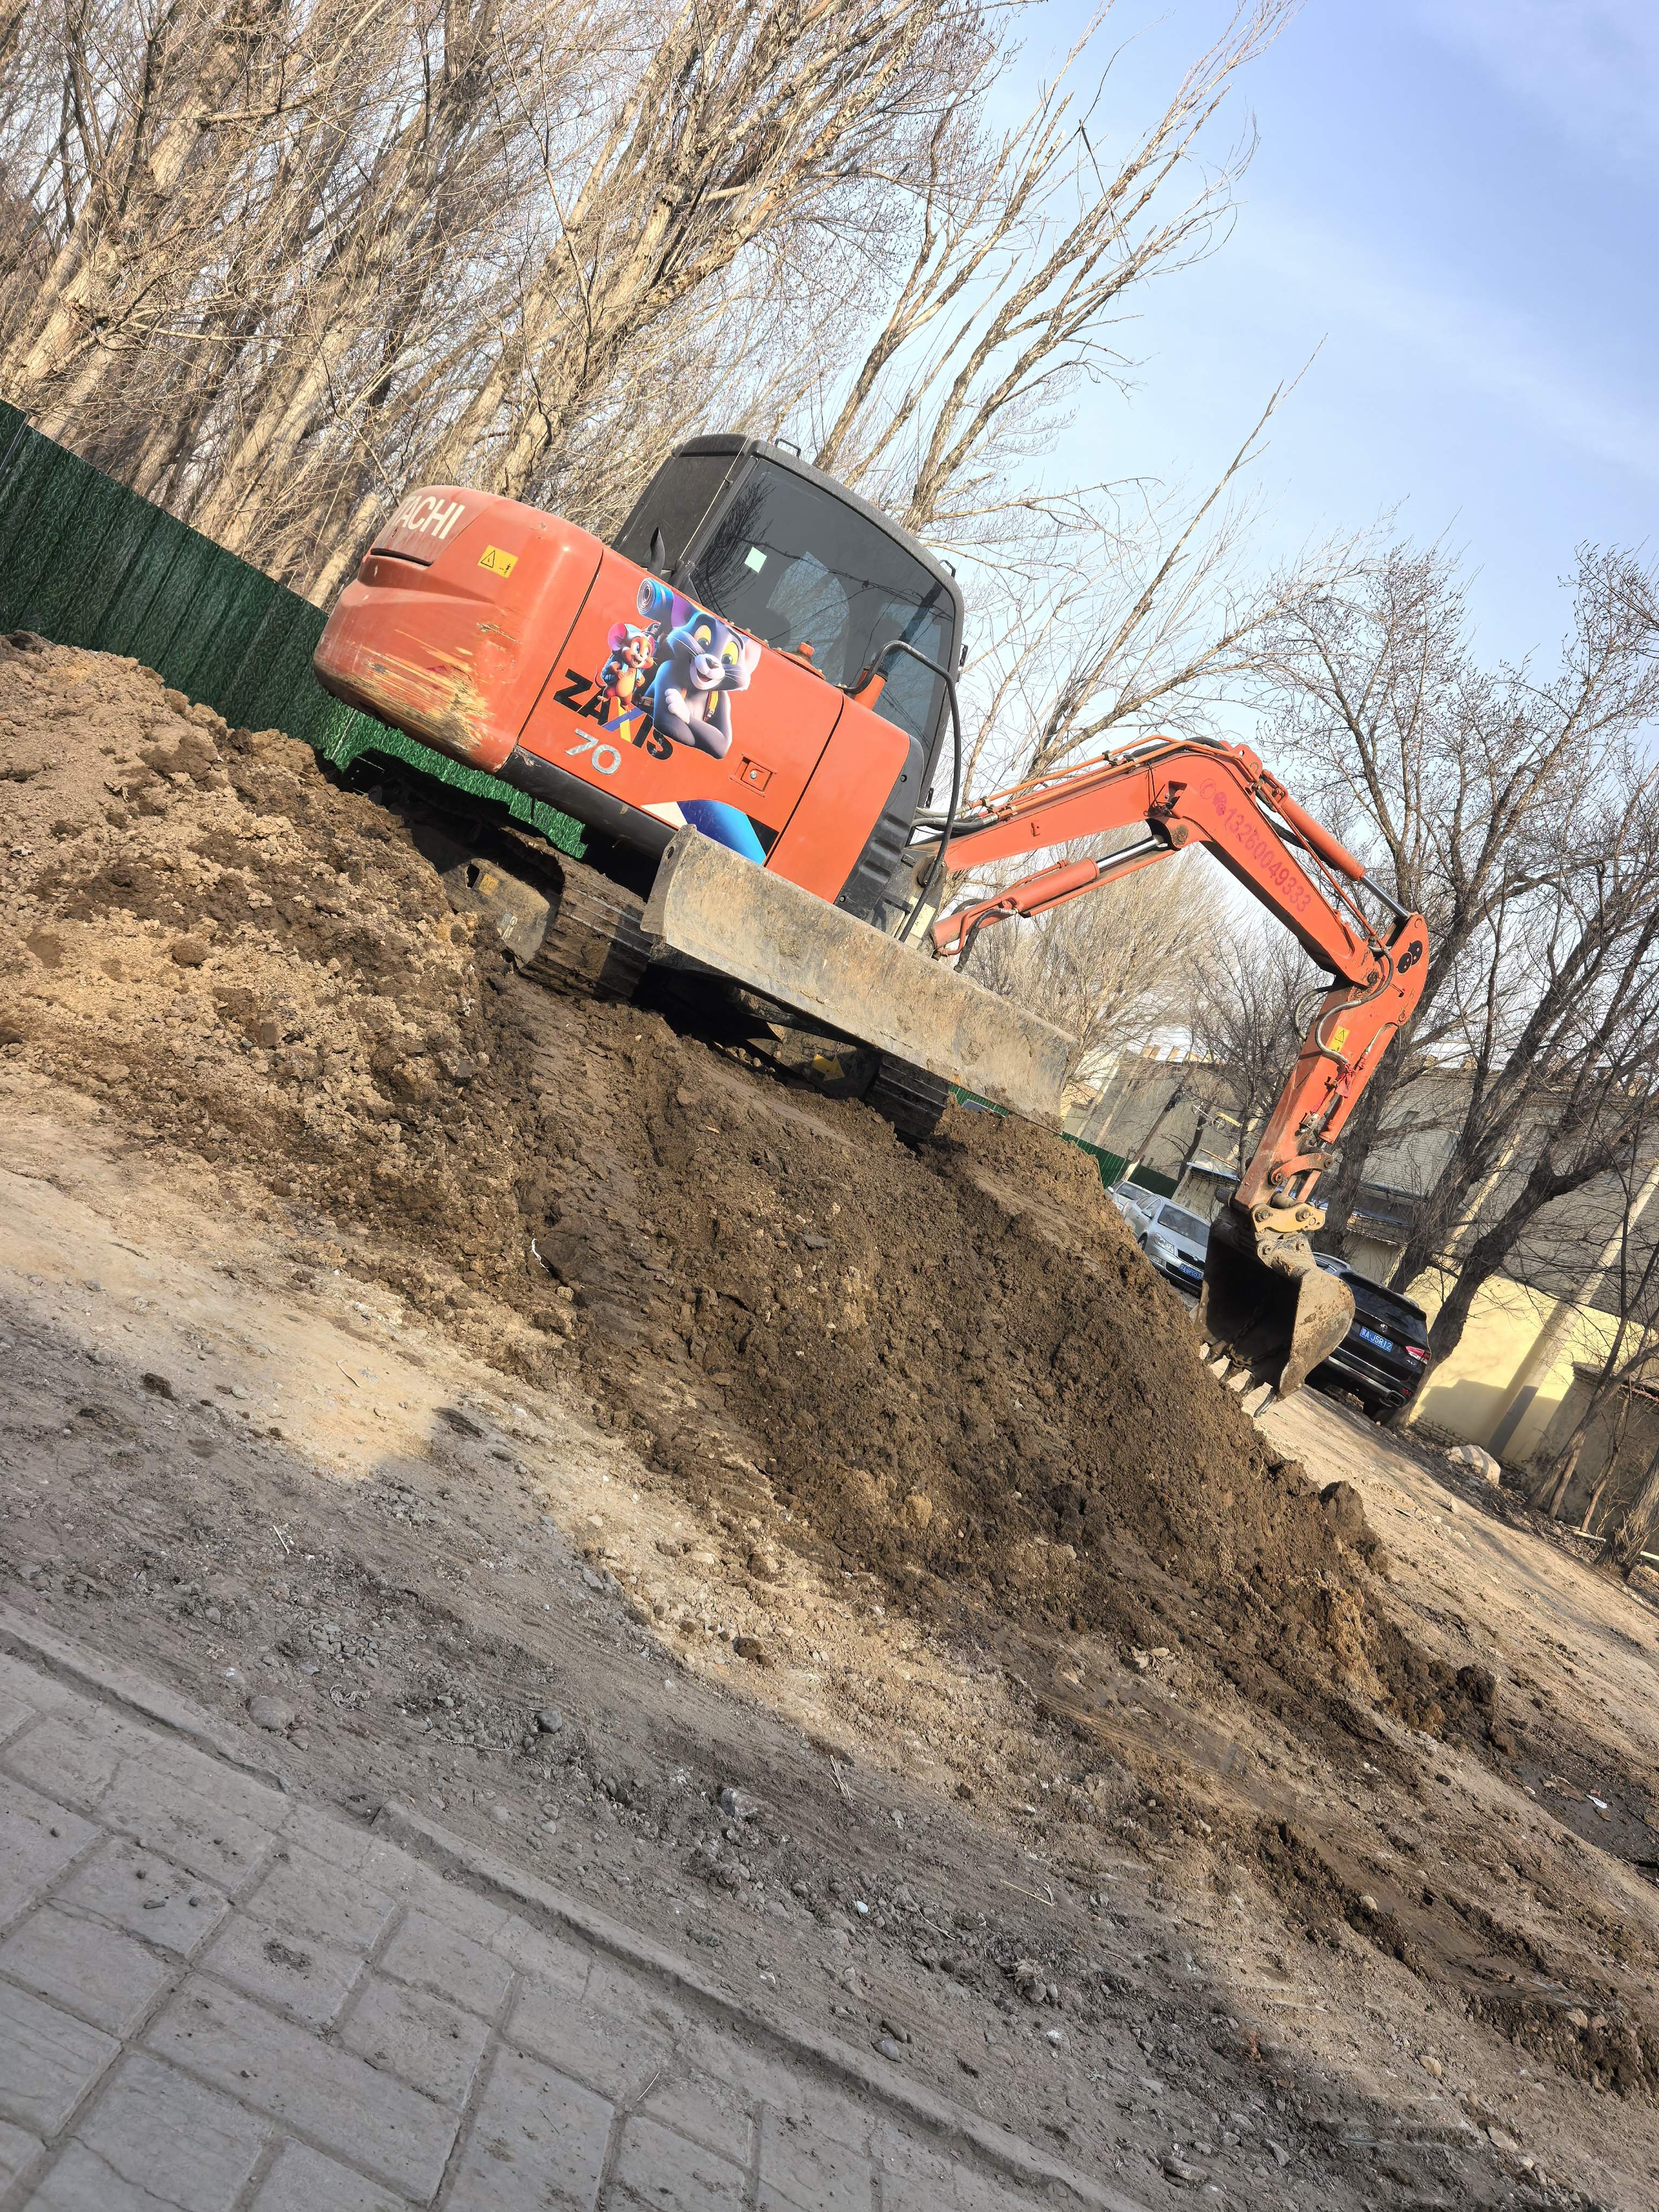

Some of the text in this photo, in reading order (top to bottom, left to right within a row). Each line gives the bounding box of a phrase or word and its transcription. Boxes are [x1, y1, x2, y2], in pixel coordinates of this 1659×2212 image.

[552, 669, 673, 760] ZAXIS
[564, 728, 622, 775] 70
[1224, 808, 1311, 912] 13260049333
